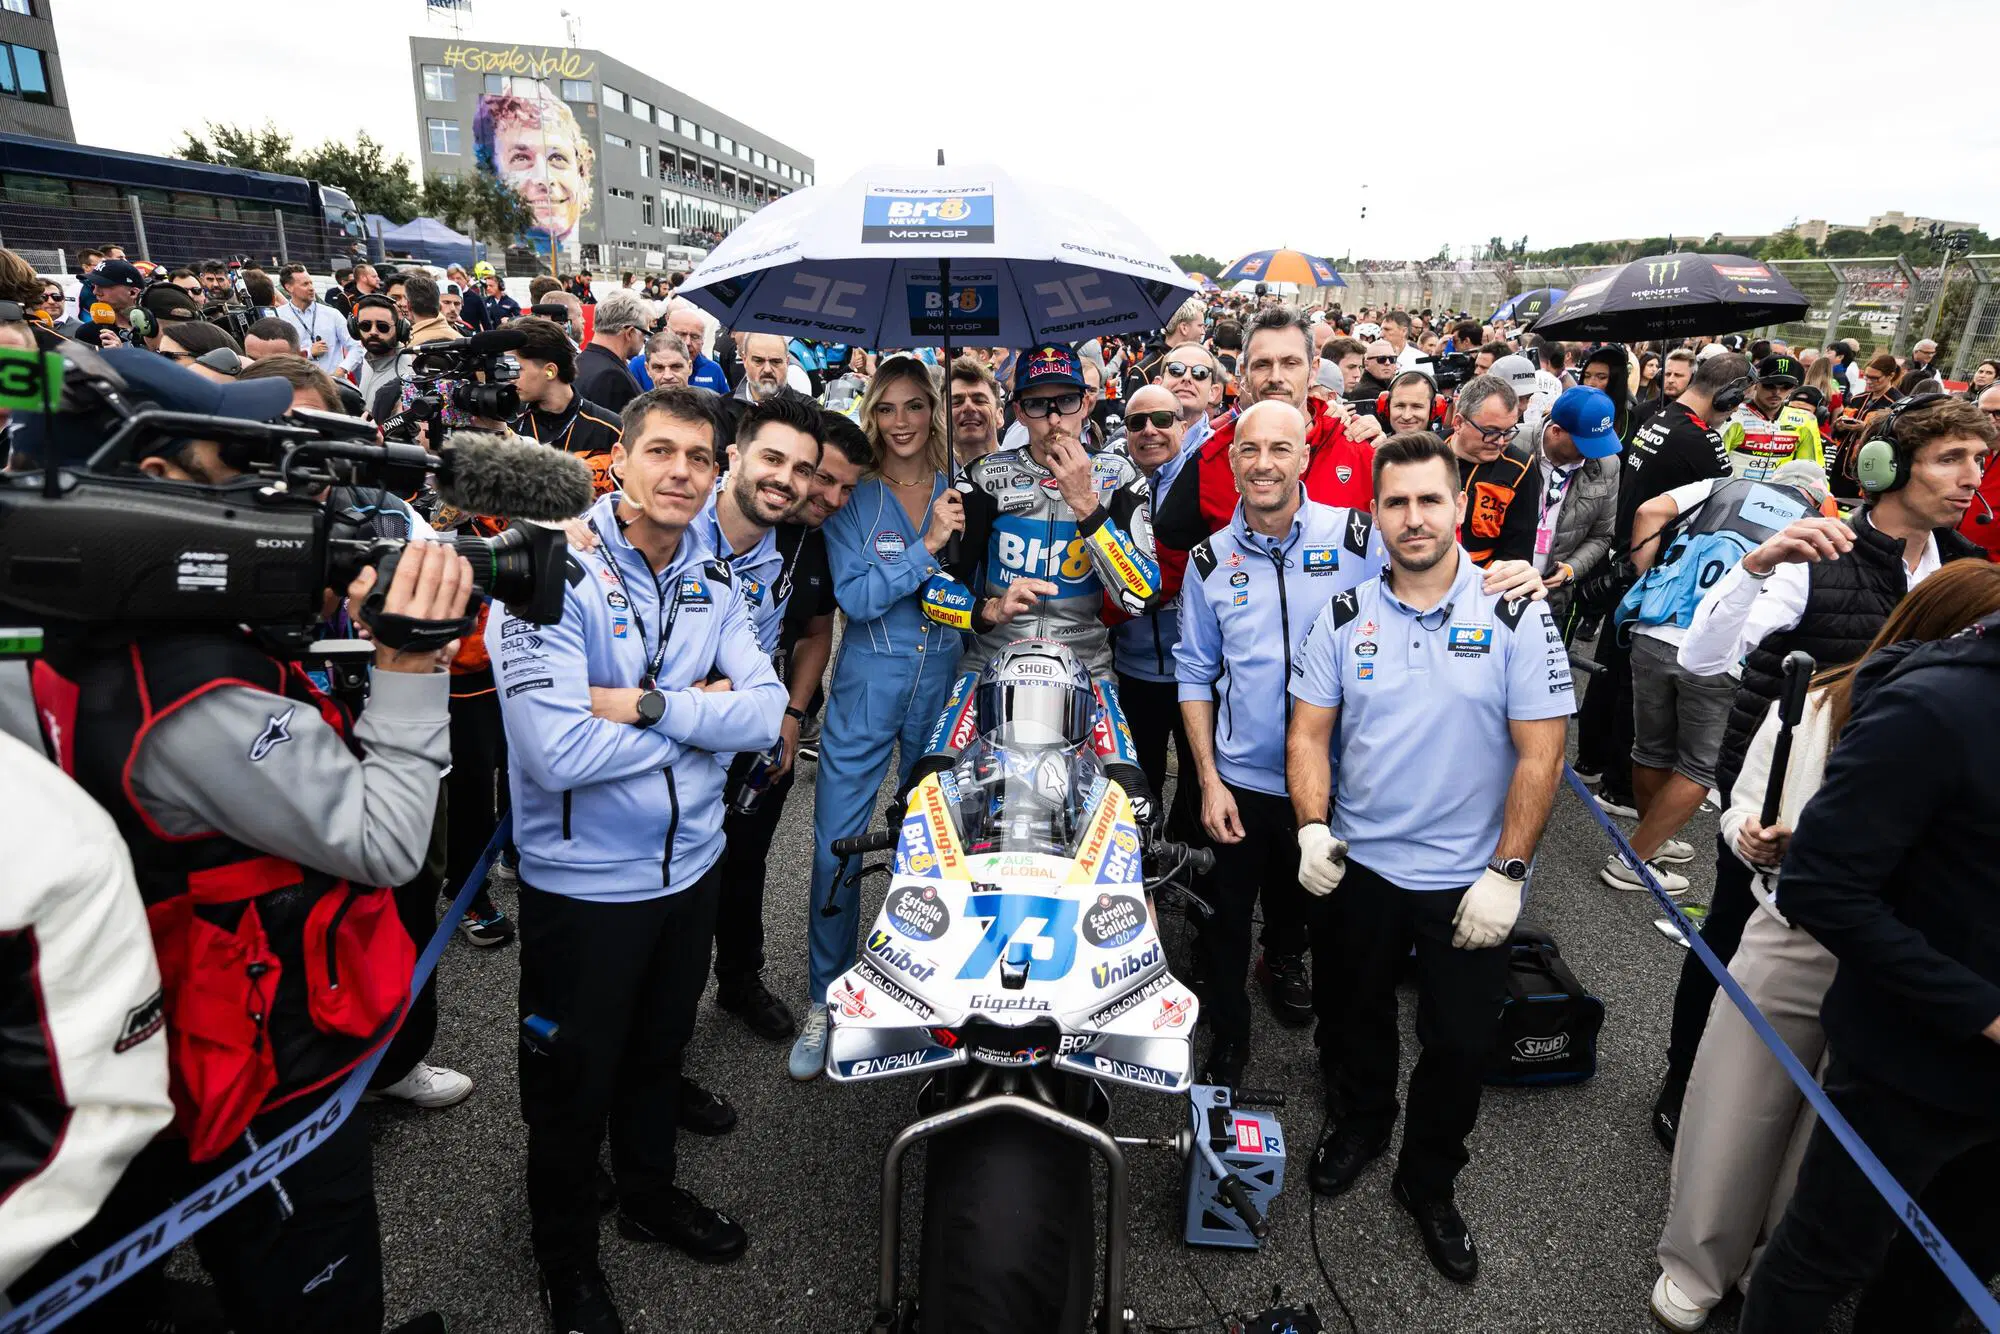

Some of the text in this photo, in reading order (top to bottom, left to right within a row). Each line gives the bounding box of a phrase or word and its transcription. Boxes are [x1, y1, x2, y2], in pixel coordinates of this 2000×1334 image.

[888, 197, 971, 221] BK8
[1060, 242, 1172, 273] GRESINI RACING
[1040, 312, 1139, 335] GRESINI RACING
[1029, 362, 1073, 379] Red Bull
[1745, 440, 1794, 451] Enduro
[985, 465, 1009, 475] SHOEI
[1628, 452, 1643, 471] ebay
[1749, 459, 1780, 469] ebay
[985, 478, 1008, 492] OLI
[1480, 495, 1504, 514] 215
[256, 539, 305, 548] SONY
[998, 530, 1096, 584] BK8
[1105, 541, 1146, 593] Antangin
[1132, 553, 1153, 580] NEWS
[926, 588, 968, 606] BK8 NEWS
[927, 605, 963, 625] Antangin
[503, 623, 535, 638] SIPEX
[501, 637, 524, 652] BOLD
[1017, 663, 1053, 676] SHOEI
[1047, 680, 1076, 691] WINGS
[924, 708, 949, 754] NEWS
[938, 770, 963, 807] ALEX
[924, 785, 957, 868] Antangin
[1079, 791, 1120, 876] Antangin
[903, 821, 938, 877] BK8
[1003, 855, 1034, 866] AUS
[1104, 826, 1140, 884] BK8
[1000, 866, 1056, 879] GLOBAL
[895, 902, 934, 934] Galicia
[902, 891, 943, 923] Estrella
[1090, 902, 1134, 928] Estrella
[955, 894, 1080, 982] 73
[1096, 914, 1138, 940] Galicia
[866, 929, 936, 982] Unibat
[1091, 943, 1160, 989] Unibat
[857, 964, 874, 981] MS
[872, 973, 904, 1000] GLOW
[970, 994, 1052, 1014] Gigetta
[1094, 1011, 1112, 1029] MS
[1110, 993, 1142, 1017] GLOW
[1153, 1006, 1179, 1029] FEDERAL
[978, 1046, 1011, 1057] wonderful
[1524, 1035, 1564, 1054] SHOEI
[870, 1050, 928, 1073] NPAW
[975, 1050, 1023, 1063] indonesia
[1112, 1060, 1168, 1085] NPAW
[179, 1099, 342, 1224] RACING
